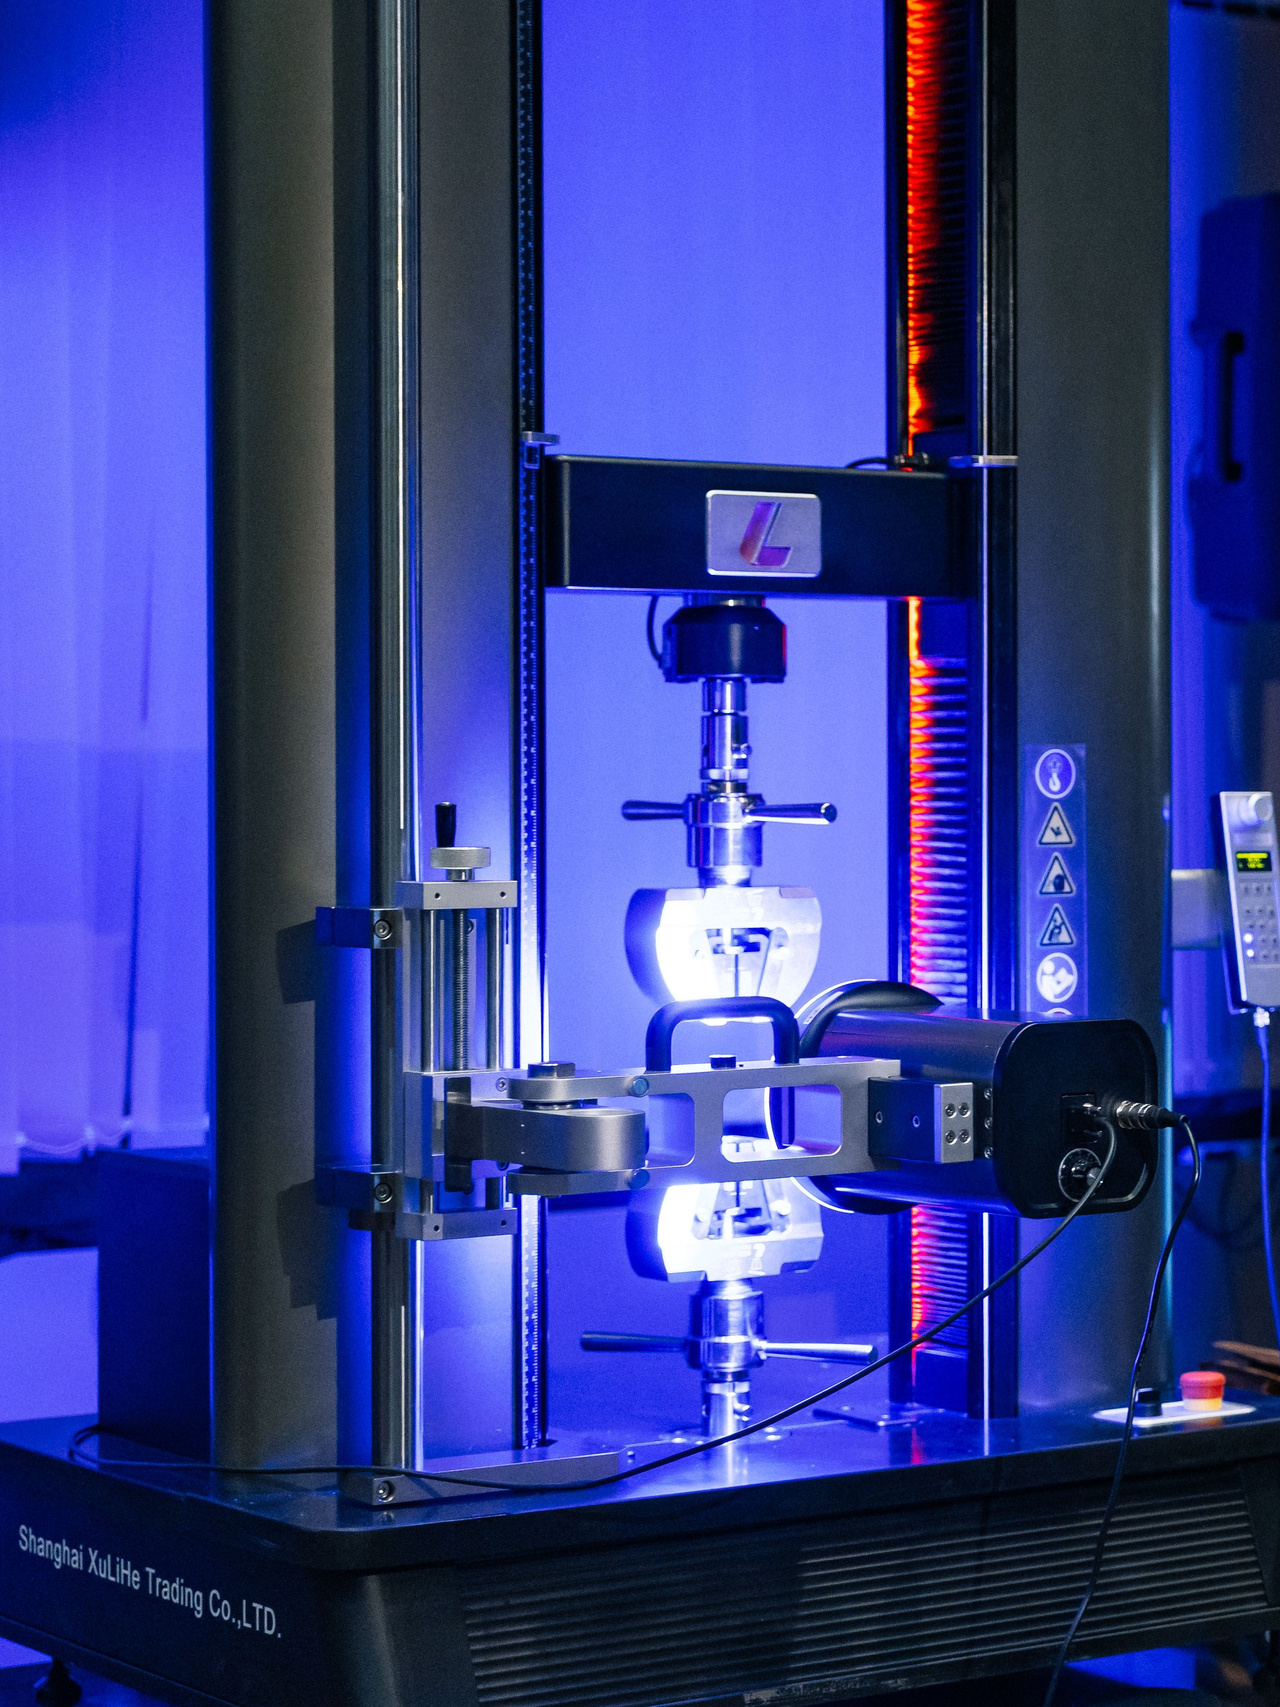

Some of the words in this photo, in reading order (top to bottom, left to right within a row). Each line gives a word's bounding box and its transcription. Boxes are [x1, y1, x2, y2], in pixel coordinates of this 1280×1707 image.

[19, 1524, 83, 1570] Shanghai
[88, 1547, 140, 1590] XuLiHe
[145, 1566, 203, 1618] Trading
[209, 1589, 282, 1638] Co.,LTD.
